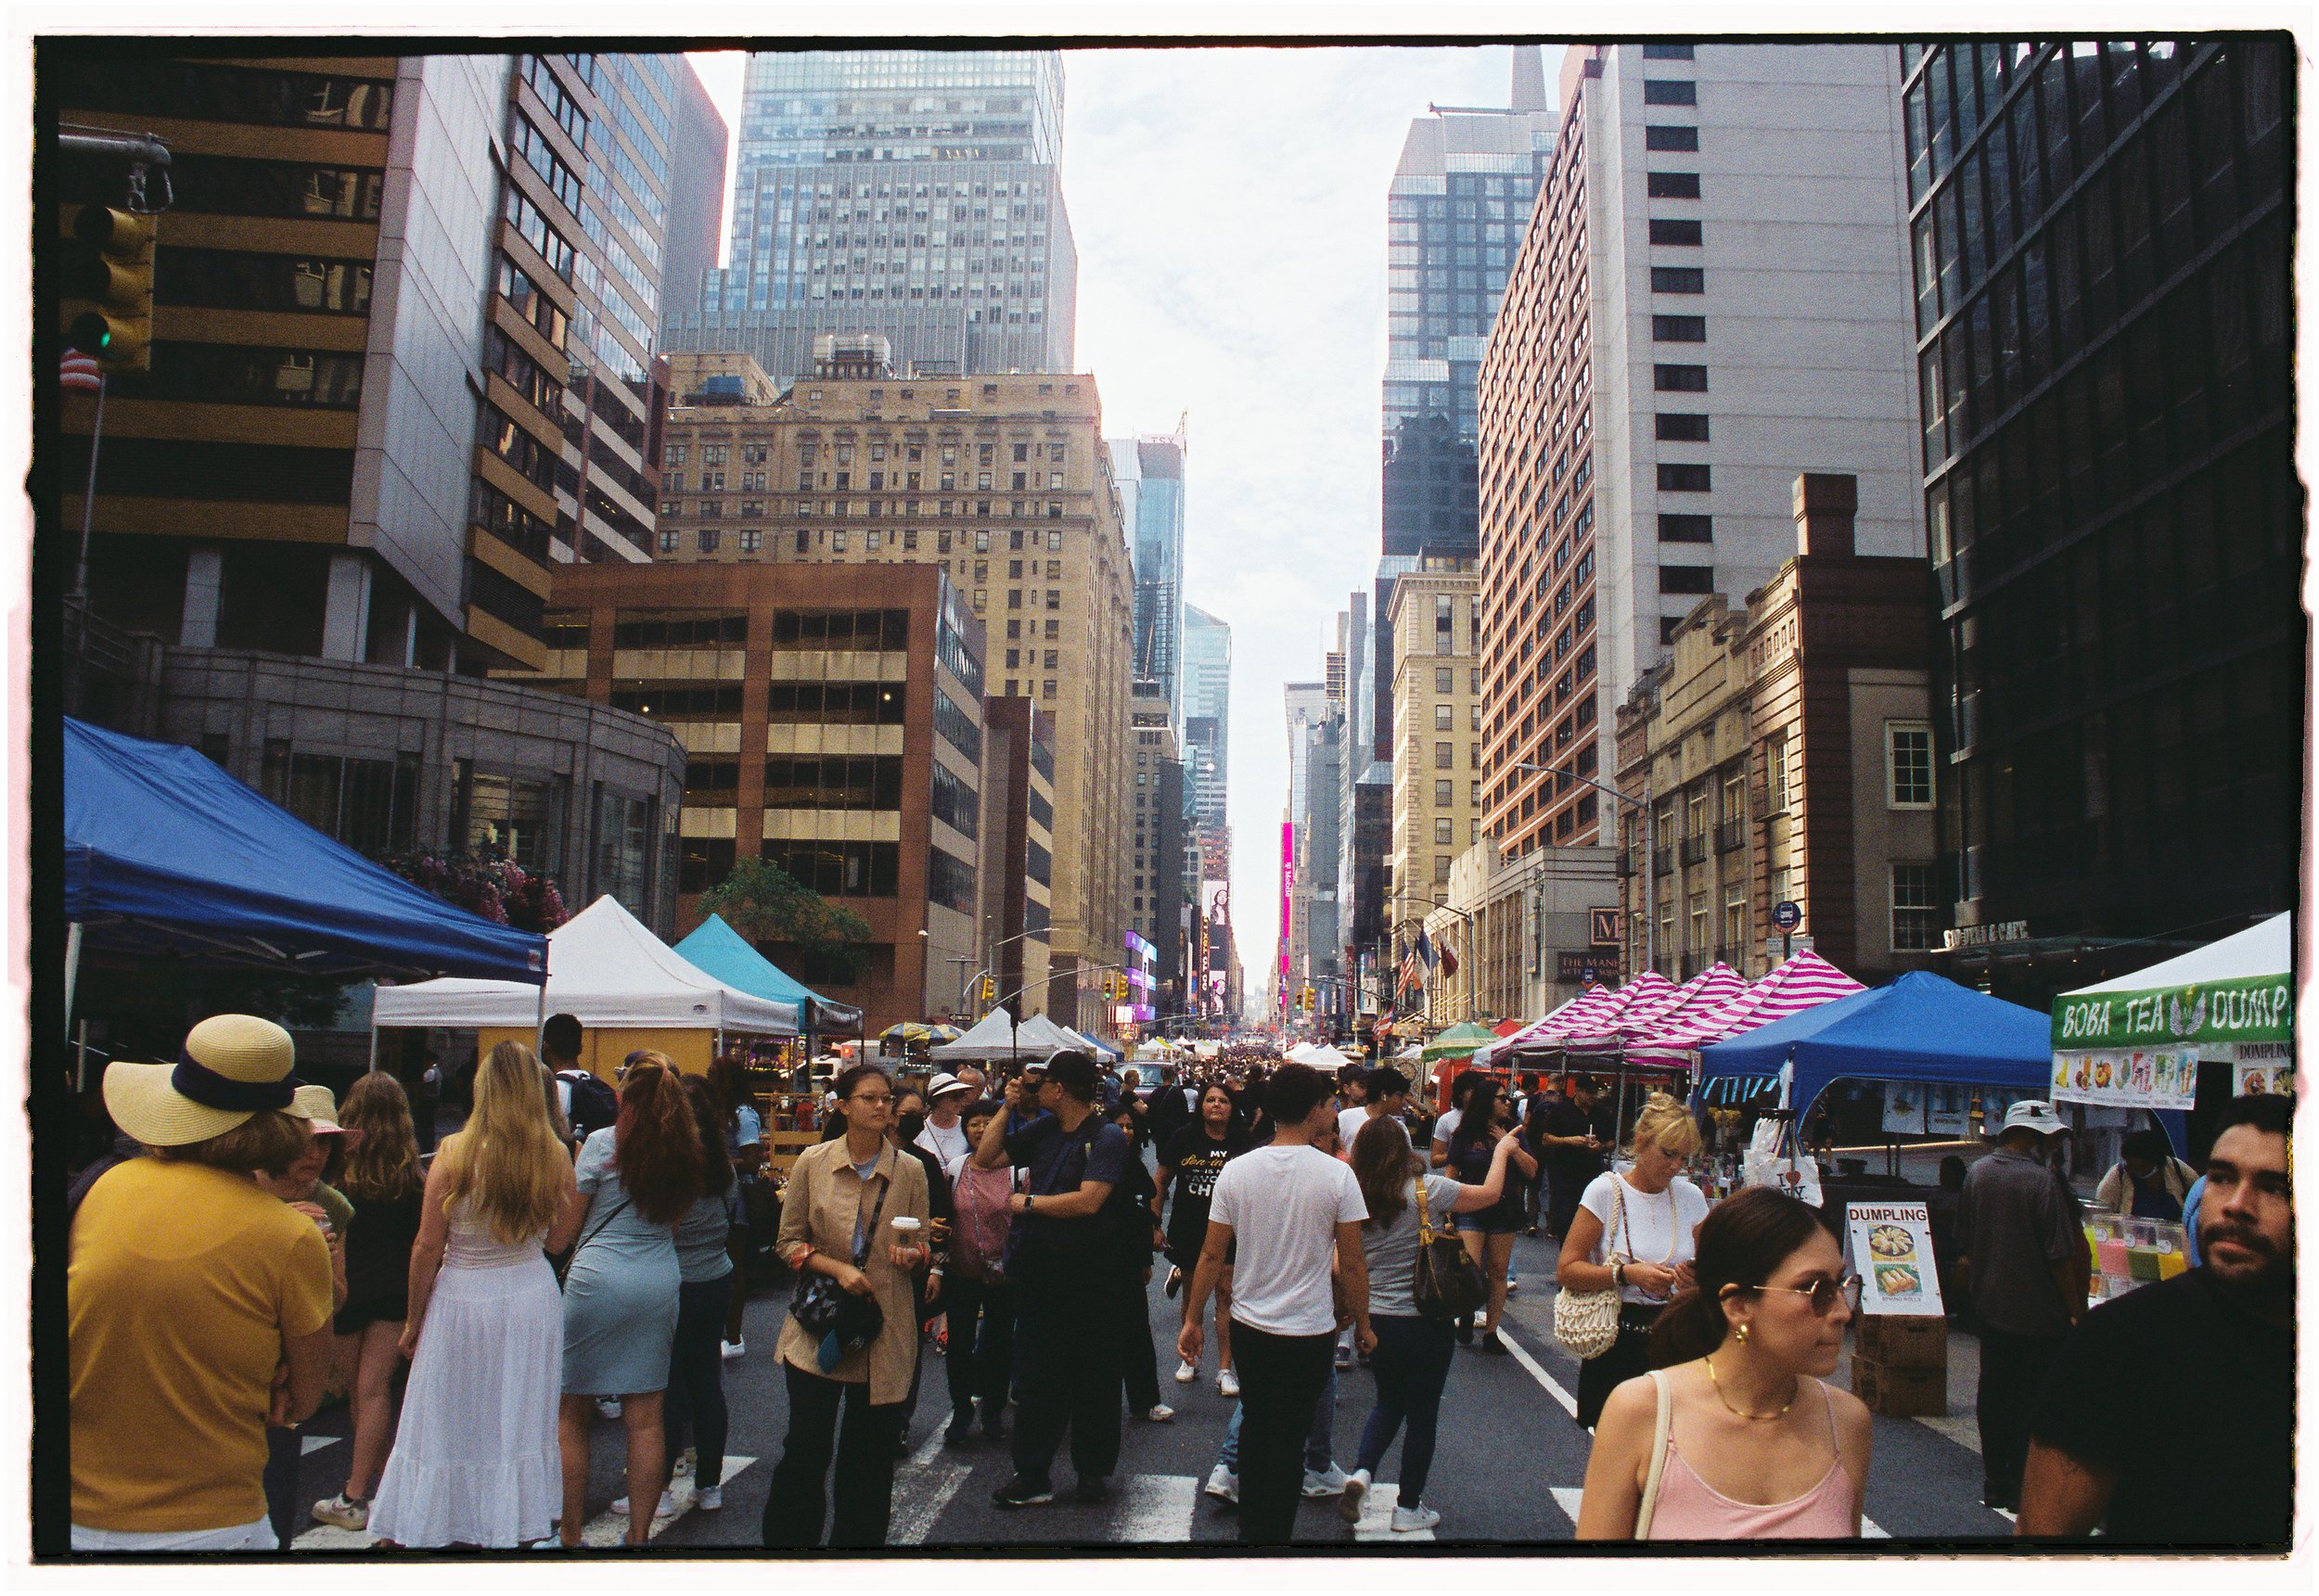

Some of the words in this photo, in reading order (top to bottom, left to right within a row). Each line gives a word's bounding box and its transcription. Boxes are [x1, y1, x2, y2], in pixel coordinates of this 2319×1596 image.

[1595, 914, 1620, 938] M
[2063, 1001, 2112, 1038] BOBA
[2125, 994, 2163, 1034] TEA
[2211, 986, 2291, 1029] DUMP
[1776, 1172, 1787, 1187] I
[1849, 1208, 1927, 1220] DUMPLING
